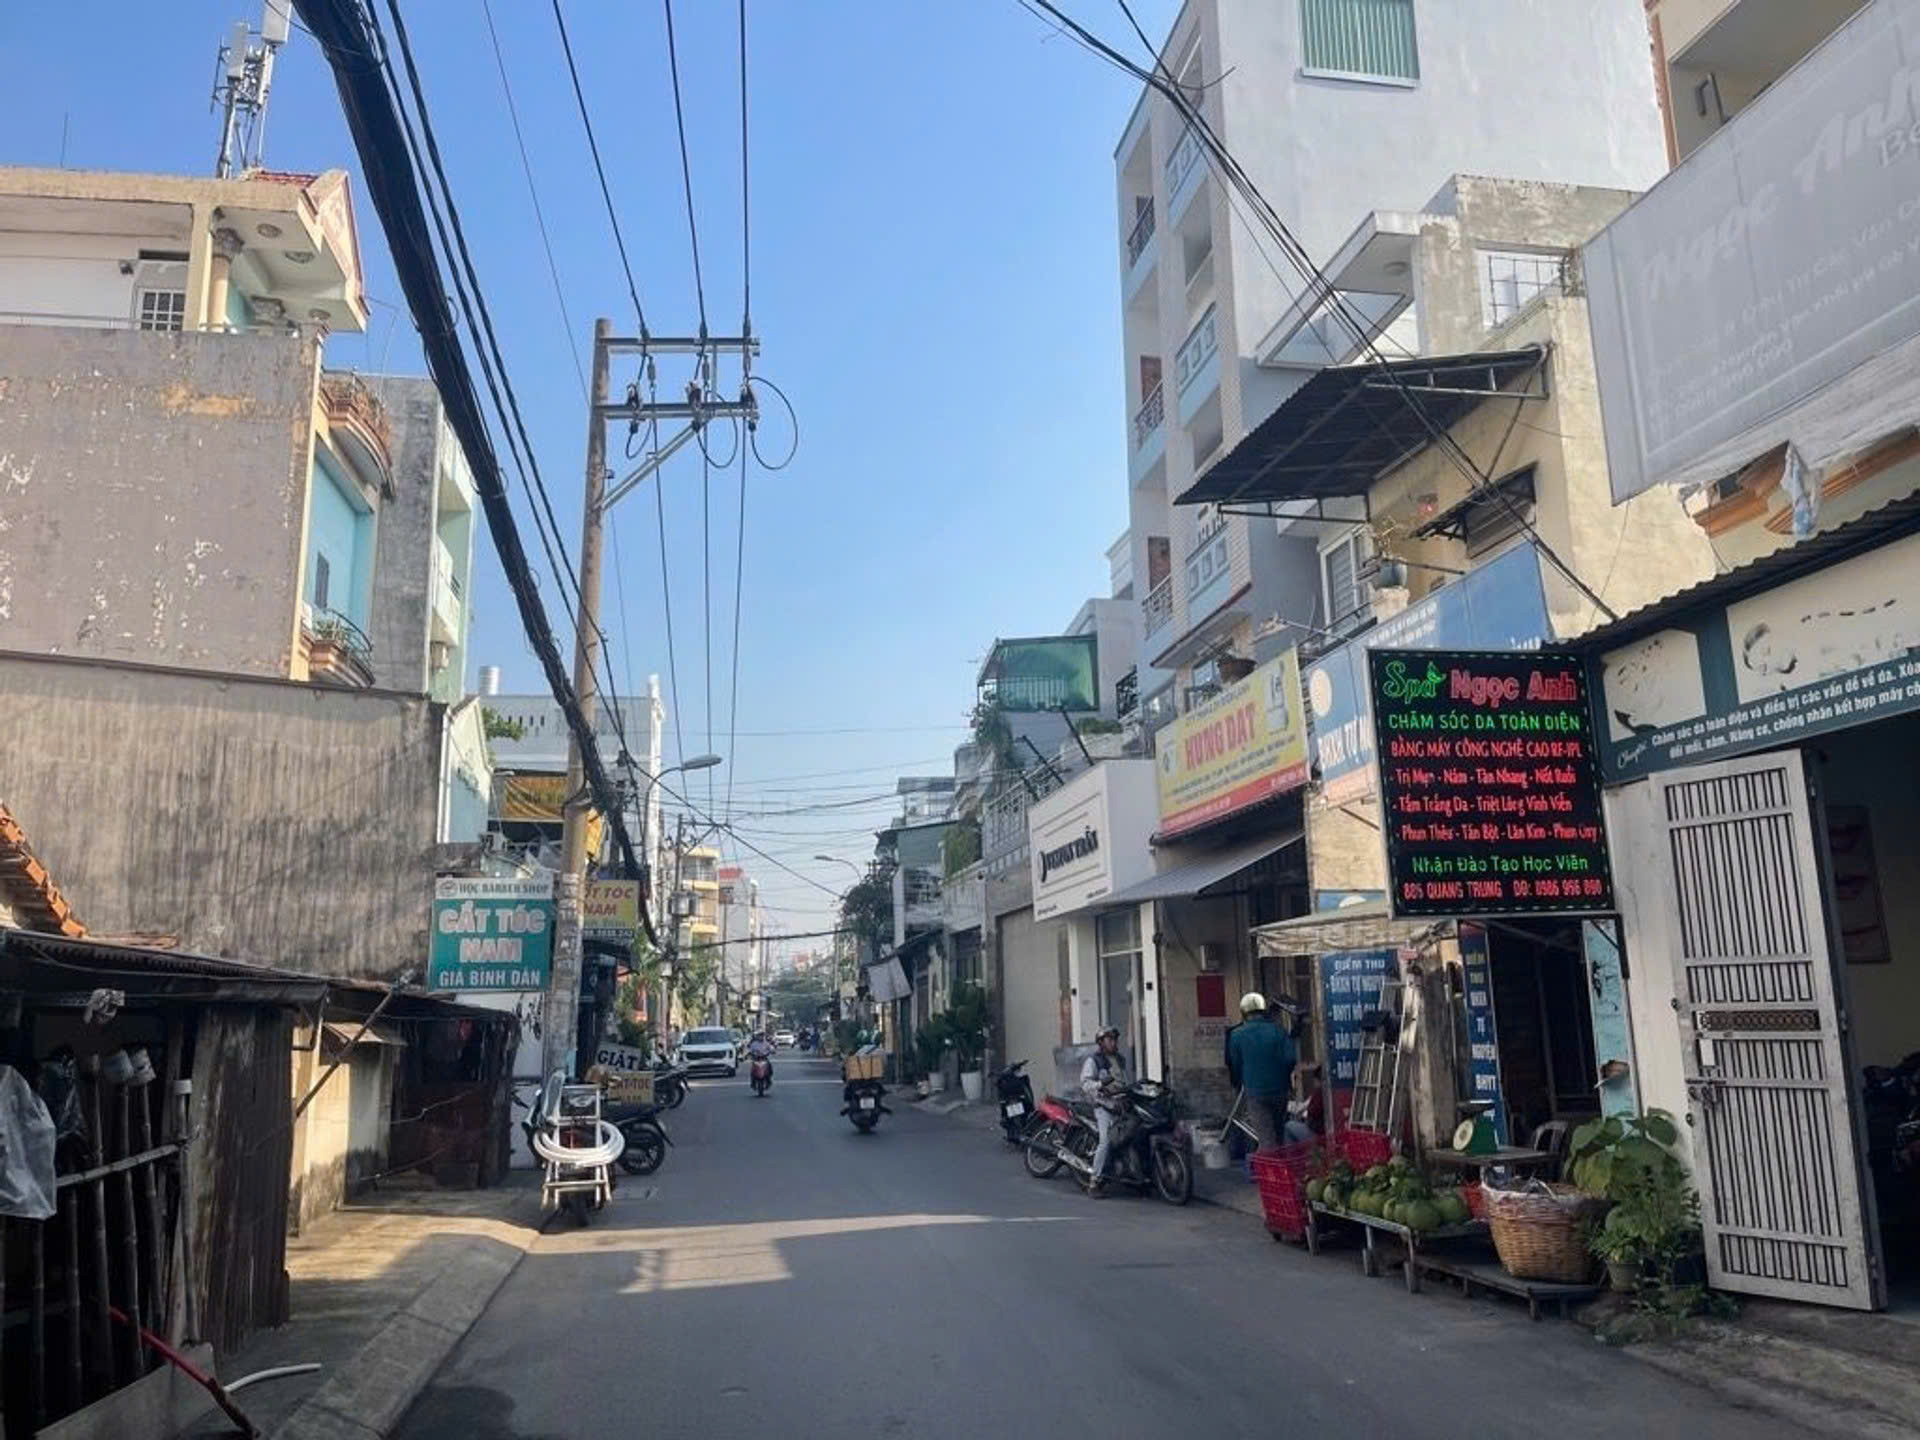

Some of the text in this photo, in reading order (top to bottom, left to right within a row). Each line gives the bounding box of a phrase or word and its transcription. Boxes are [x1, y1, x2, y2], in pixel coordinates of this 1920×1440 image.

[1383, 661, 1577, 708] Spa Ngọc Anh
[1389, 709, 1580, 733] CHĂM SÓC DA TOÀN DIỆN
[1427, 737, 1450, 757] MÁY
[1526, 741, 1549, 757] CAO
[1453, 796, 1468, 811] Da
[1412, 854, 1588, 877] Nhận Đào Tạo Học Viên
[1426, 881, 1464, 899] QUANG
[1465, 880, 1503, 898] TRUNG
[439, 900, 546, 933] CẮT TÓC
[459, 937, 523, 963] NAM
[470, 967, 506, 987] BÌNH
